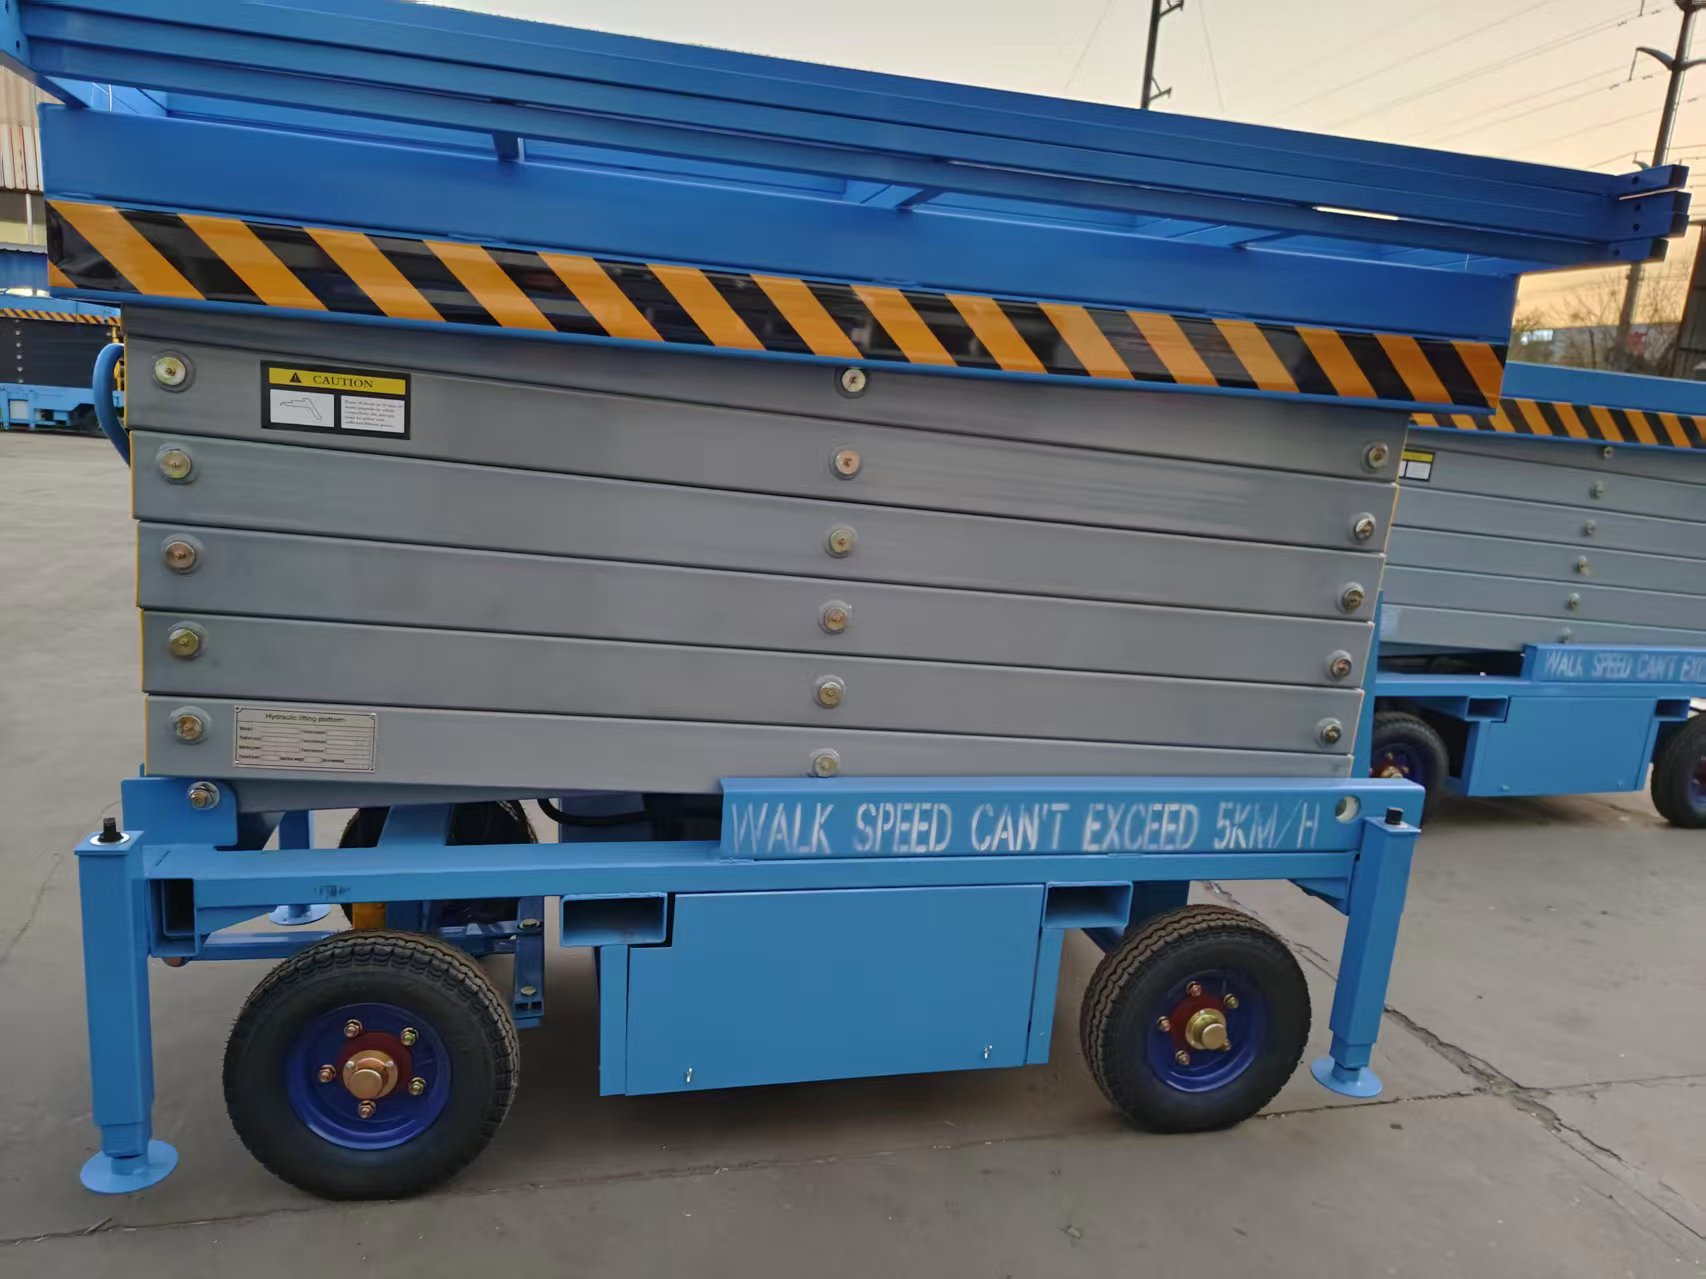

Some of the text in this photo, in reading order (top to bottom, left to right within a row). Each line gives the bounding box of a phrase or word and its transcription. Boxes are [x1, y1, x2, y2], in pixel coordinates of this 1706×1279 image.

[312, 375, 375, 388] CAUTION
[265, 713, 297, 723] Hydraulic
[731, 801, 1322, 855] WALK SPEED CAN'T EXCEED 5KM/H
